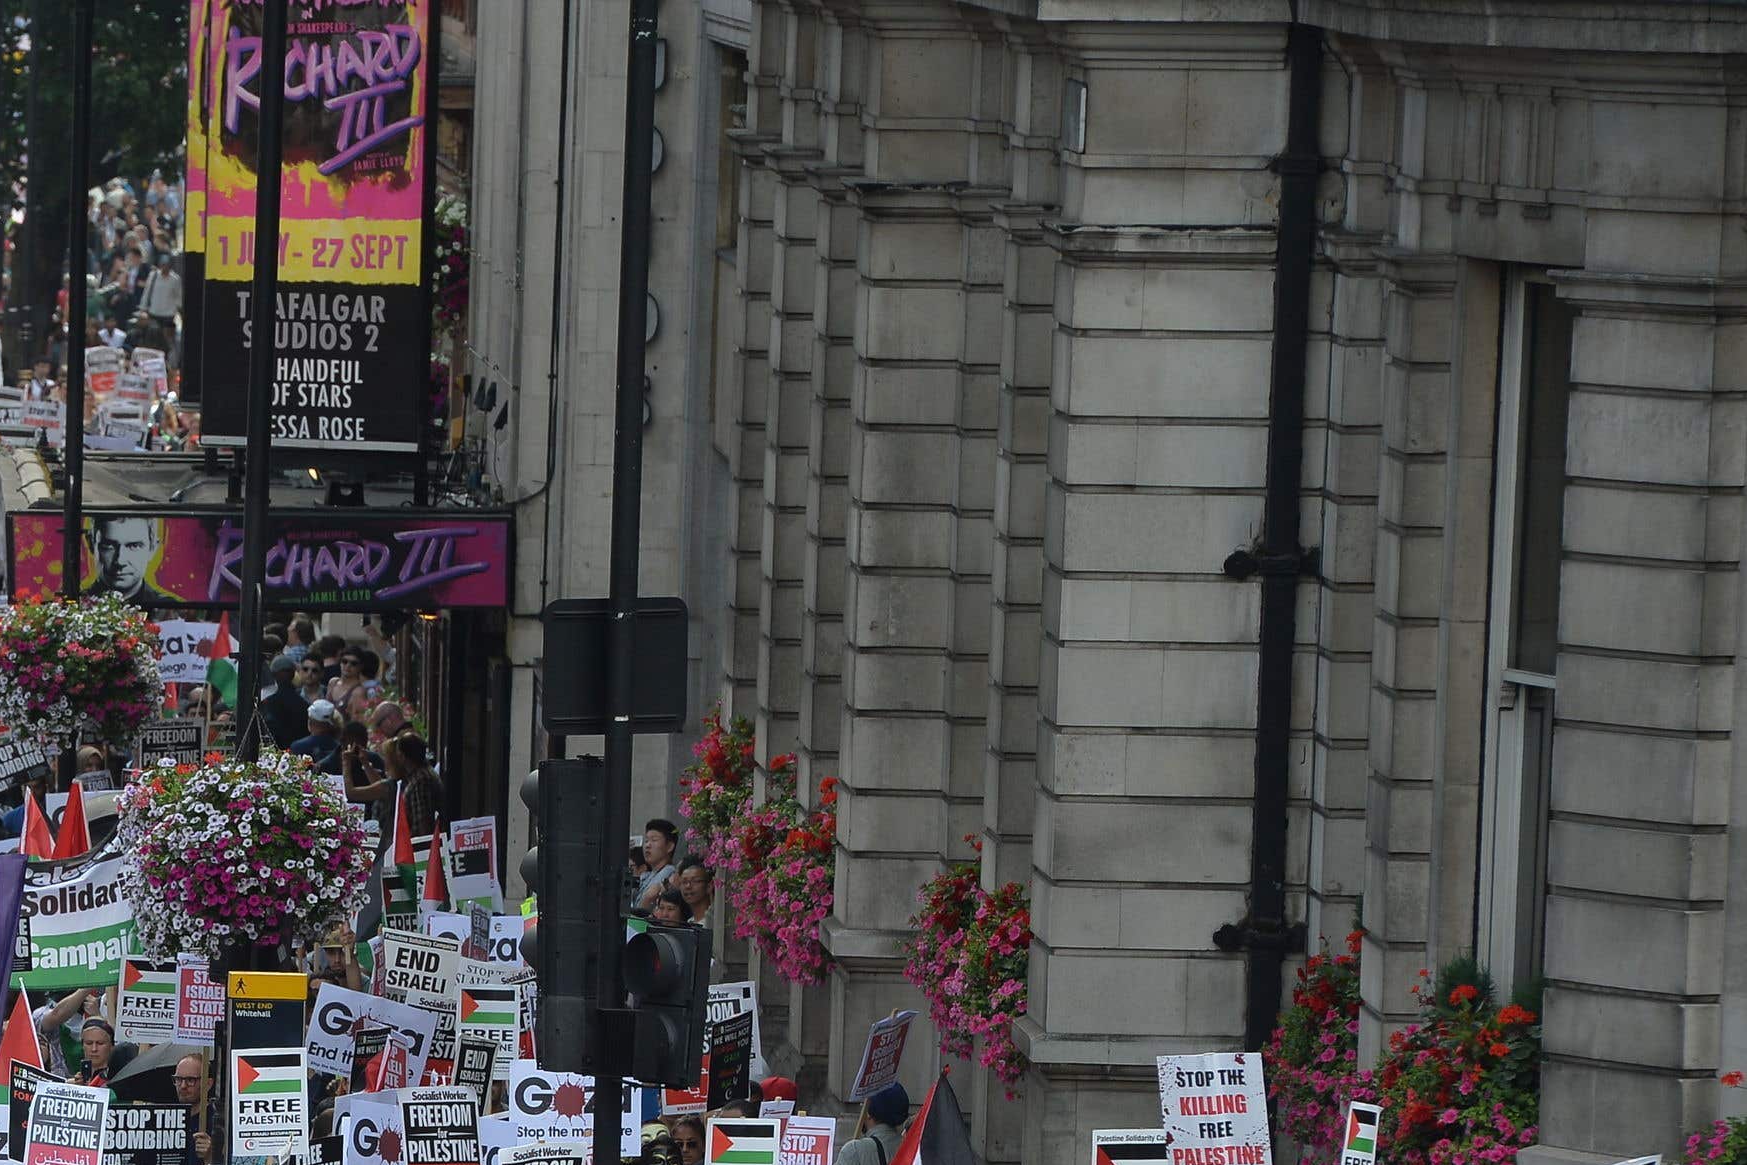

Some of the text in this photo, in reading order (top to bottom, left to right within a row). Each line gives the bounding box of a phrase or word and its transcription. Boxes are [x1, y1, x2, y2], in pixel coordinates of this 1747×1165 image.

[219, 236, 228, 265] 1
[237, 231, 289, 266] JUY
[312, 238, 343, 267] 27
[350, 234, 408, 269] SEPT
[236, 291, 385, 323] TAFALGAR
[243, 321, 379, 352] SUDIOS 2
[277, 358, 363, 384] HANDFUL
[298, 384, 351, 408] STARS
[319, 417, 364, 441] ROSE
[209, 519, 490, 600] RCHARD III
[122, 996, 175, 1010] FREE
[122, 1008, 174, 1020] PALESTINE
[235, 1010, 271, 1018] Whitehall
[1176, 1068, 1245, 1087] STOP THE
[38, 1097, 100, 1124] FREEDOM
[239, 1100, 301, 1113] FREE
[410, 1105, 472, 1128] FREEDOM
[1180, 1095, 1247, 1116] KILLING
[239, 1114, 301, 1125] PALESTINE
[1199, 1121, 1233, 1139] FREE
[32, 1122, 99, 1150] PALESTINE
[409, 1138, 477, 1163] PALESTINE
